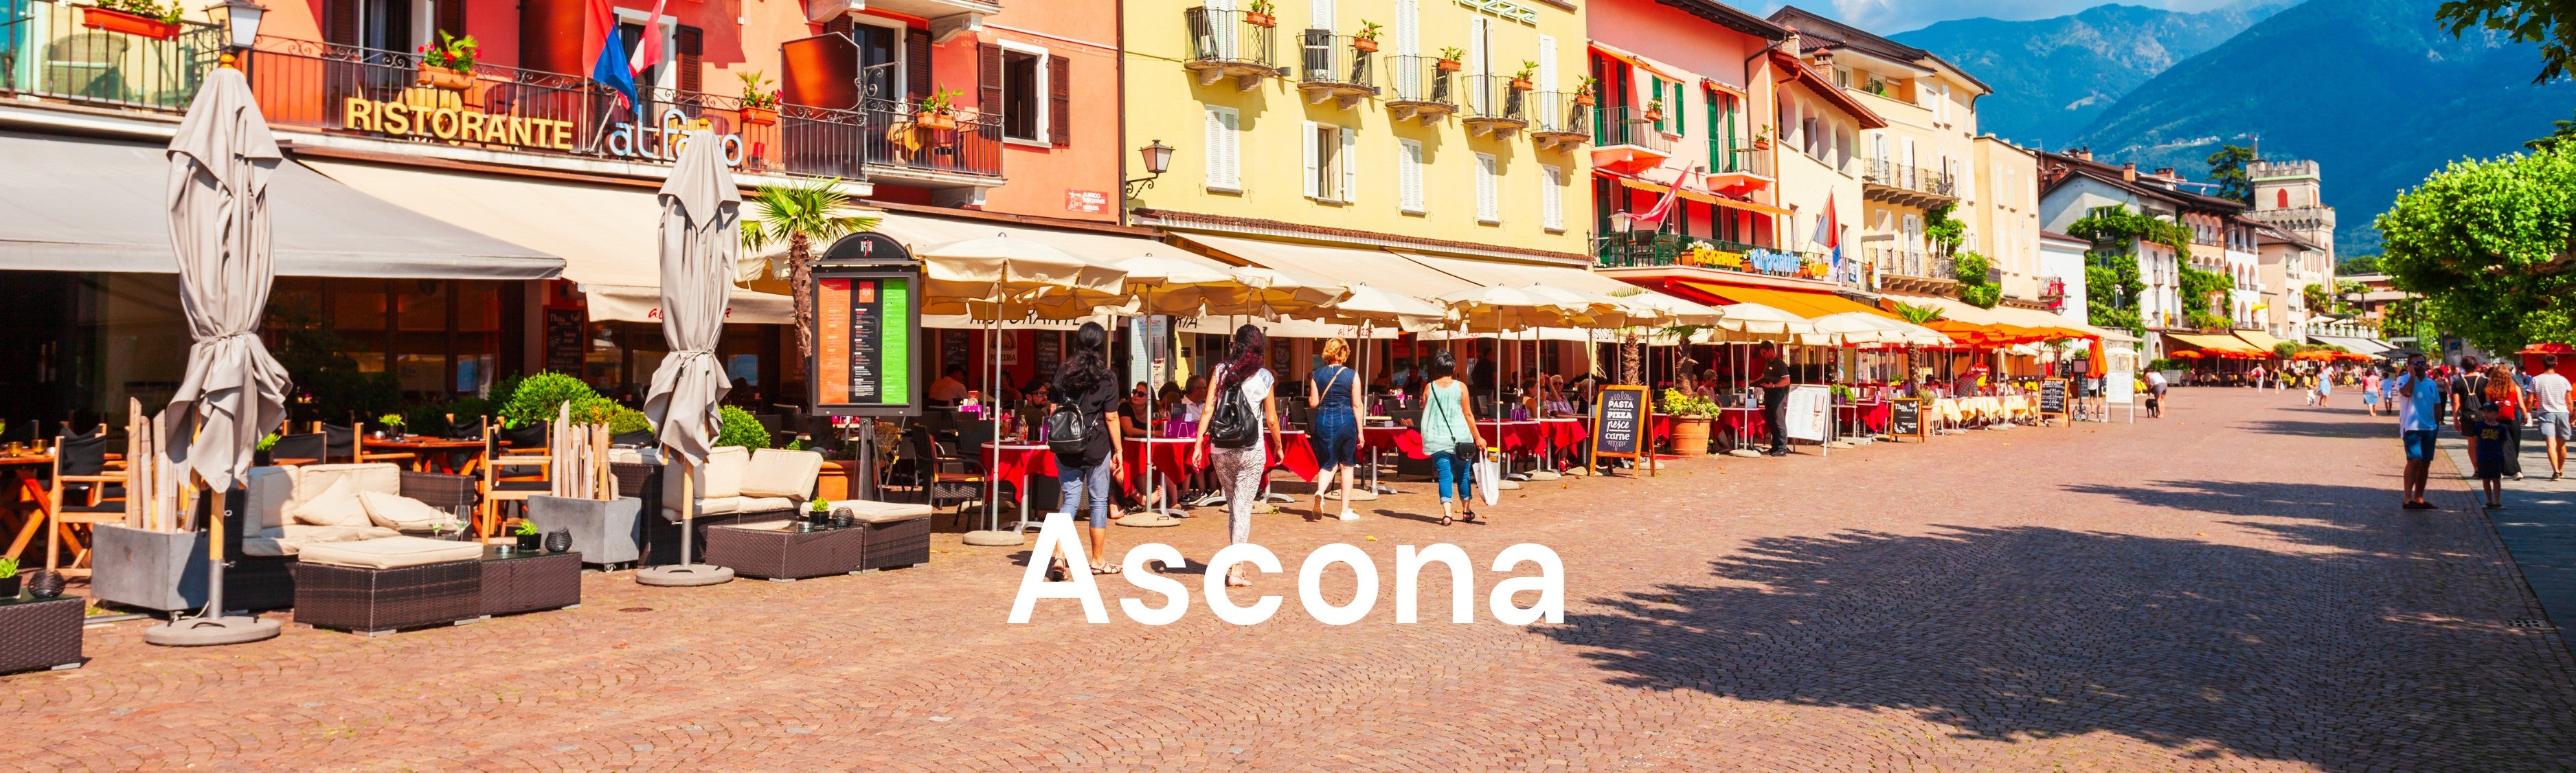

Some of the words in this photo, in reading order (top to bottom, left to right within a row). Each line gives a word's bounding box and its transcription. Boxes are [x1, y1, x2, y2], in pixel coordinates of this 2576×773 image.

[346, 98, 574, 150] RISTORANTE
[607, 104, 653, 158] al
[660, 108, 743, 166] fo
[1608, 401, 1634, 409] PASTA
[1607, 411, 1633, 419] PIZZA
[1606, 420, 1630, 432] pesce
[1605, 432, 1630, 440] carne
